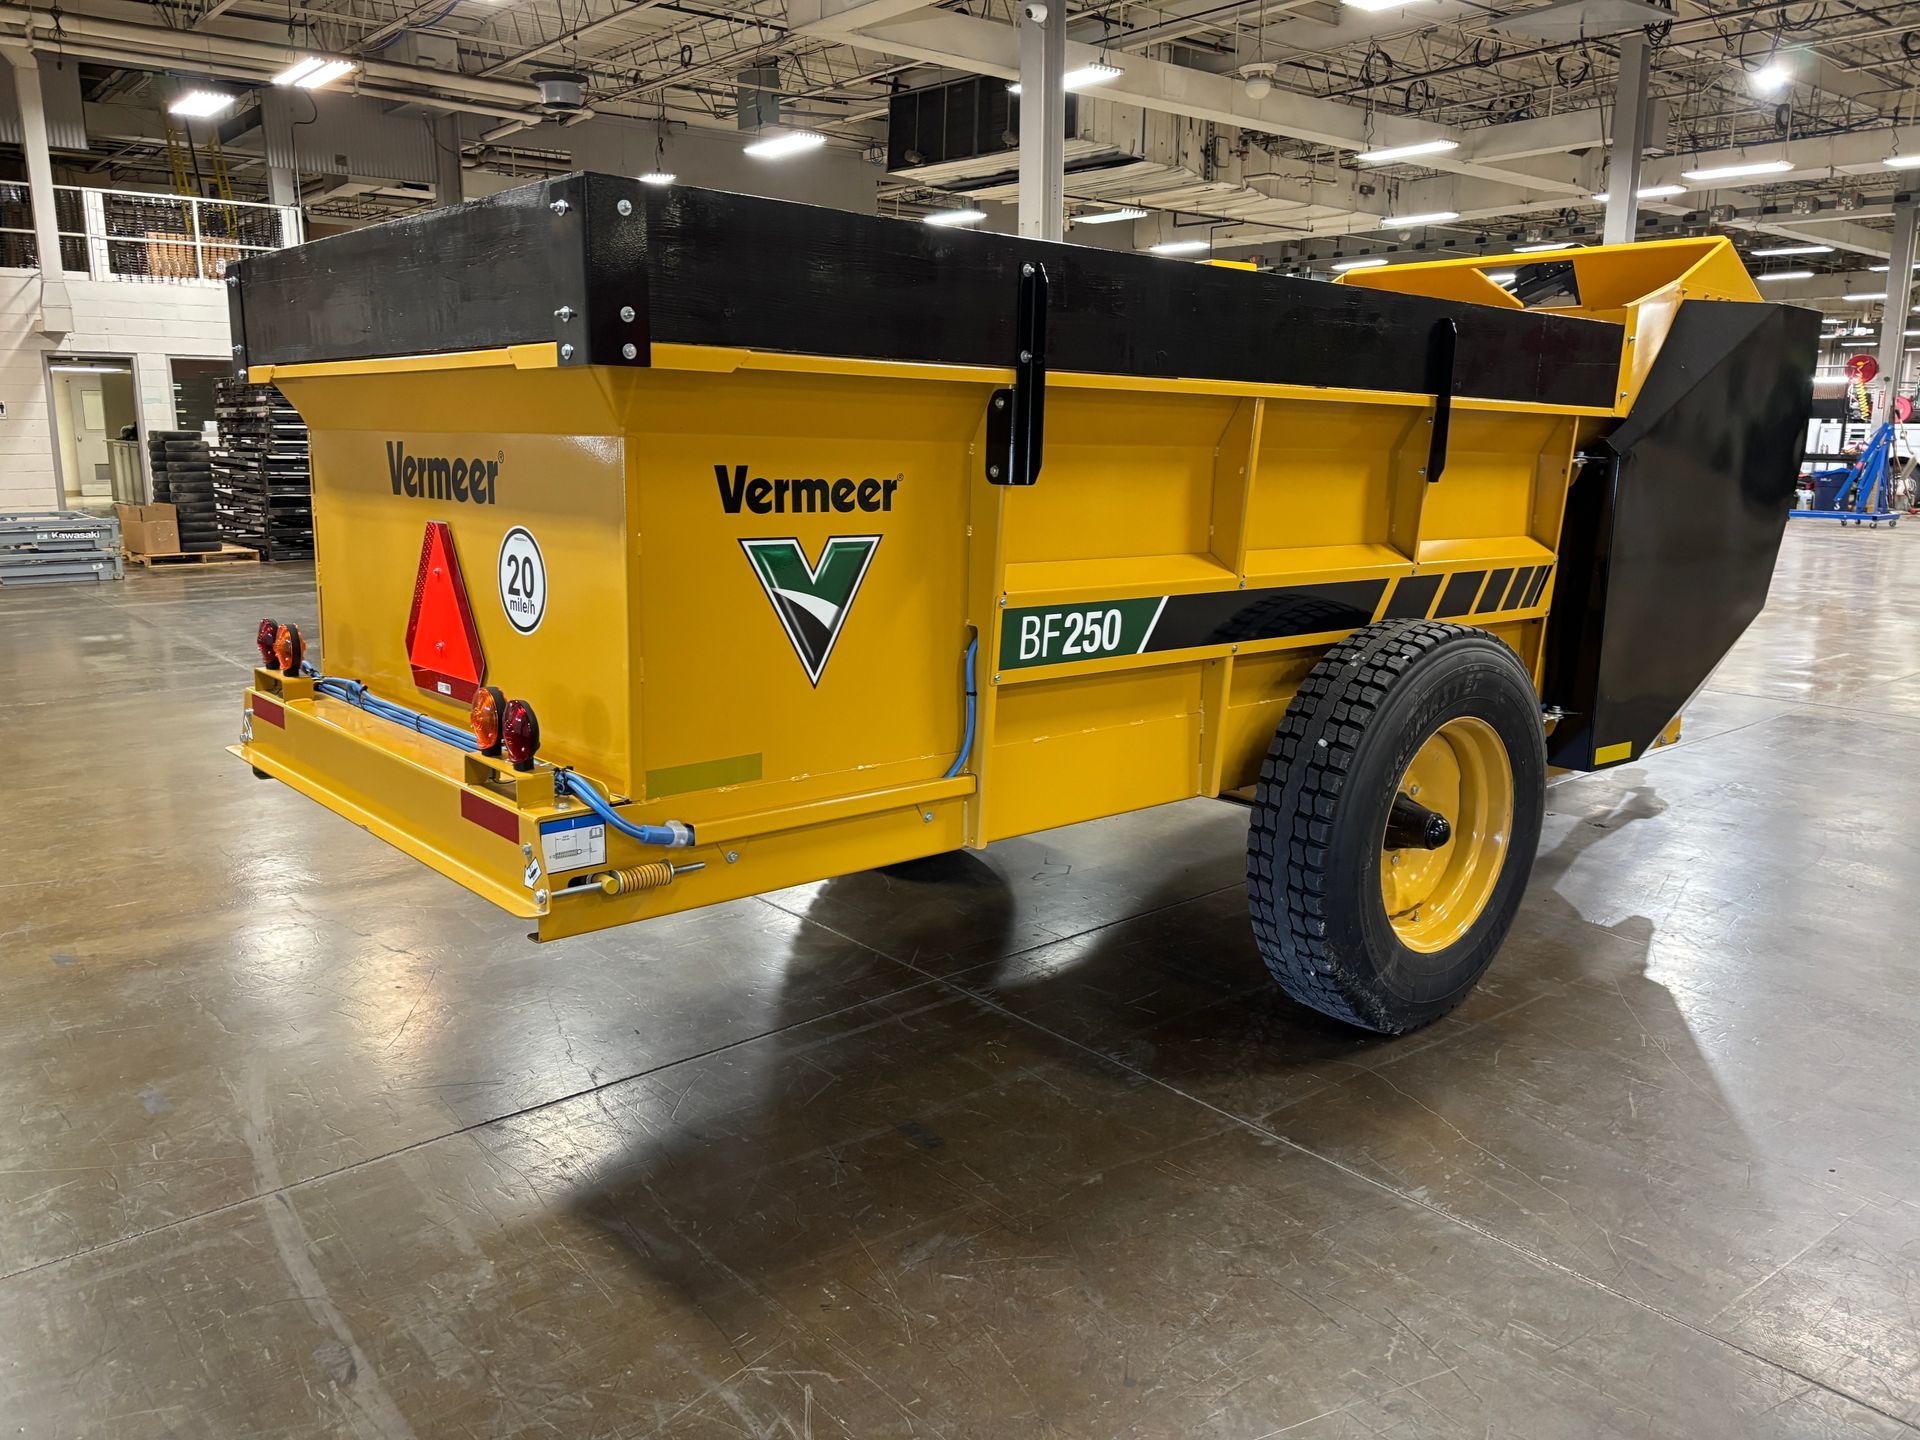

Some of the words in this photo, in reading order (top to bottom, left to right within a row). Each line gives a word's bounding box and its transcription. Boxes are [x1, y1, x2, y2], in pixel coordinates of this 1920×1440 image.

[1797, 201, 1808, 209] 93
[1841, 198, 1853, 207] 95
[51, 530, 100, 539] Kawasaki
[507, 554, 534, 599] 20
[509, 598, 535, 615] mile/h
[1019, 608, 1122, 660] BF250
